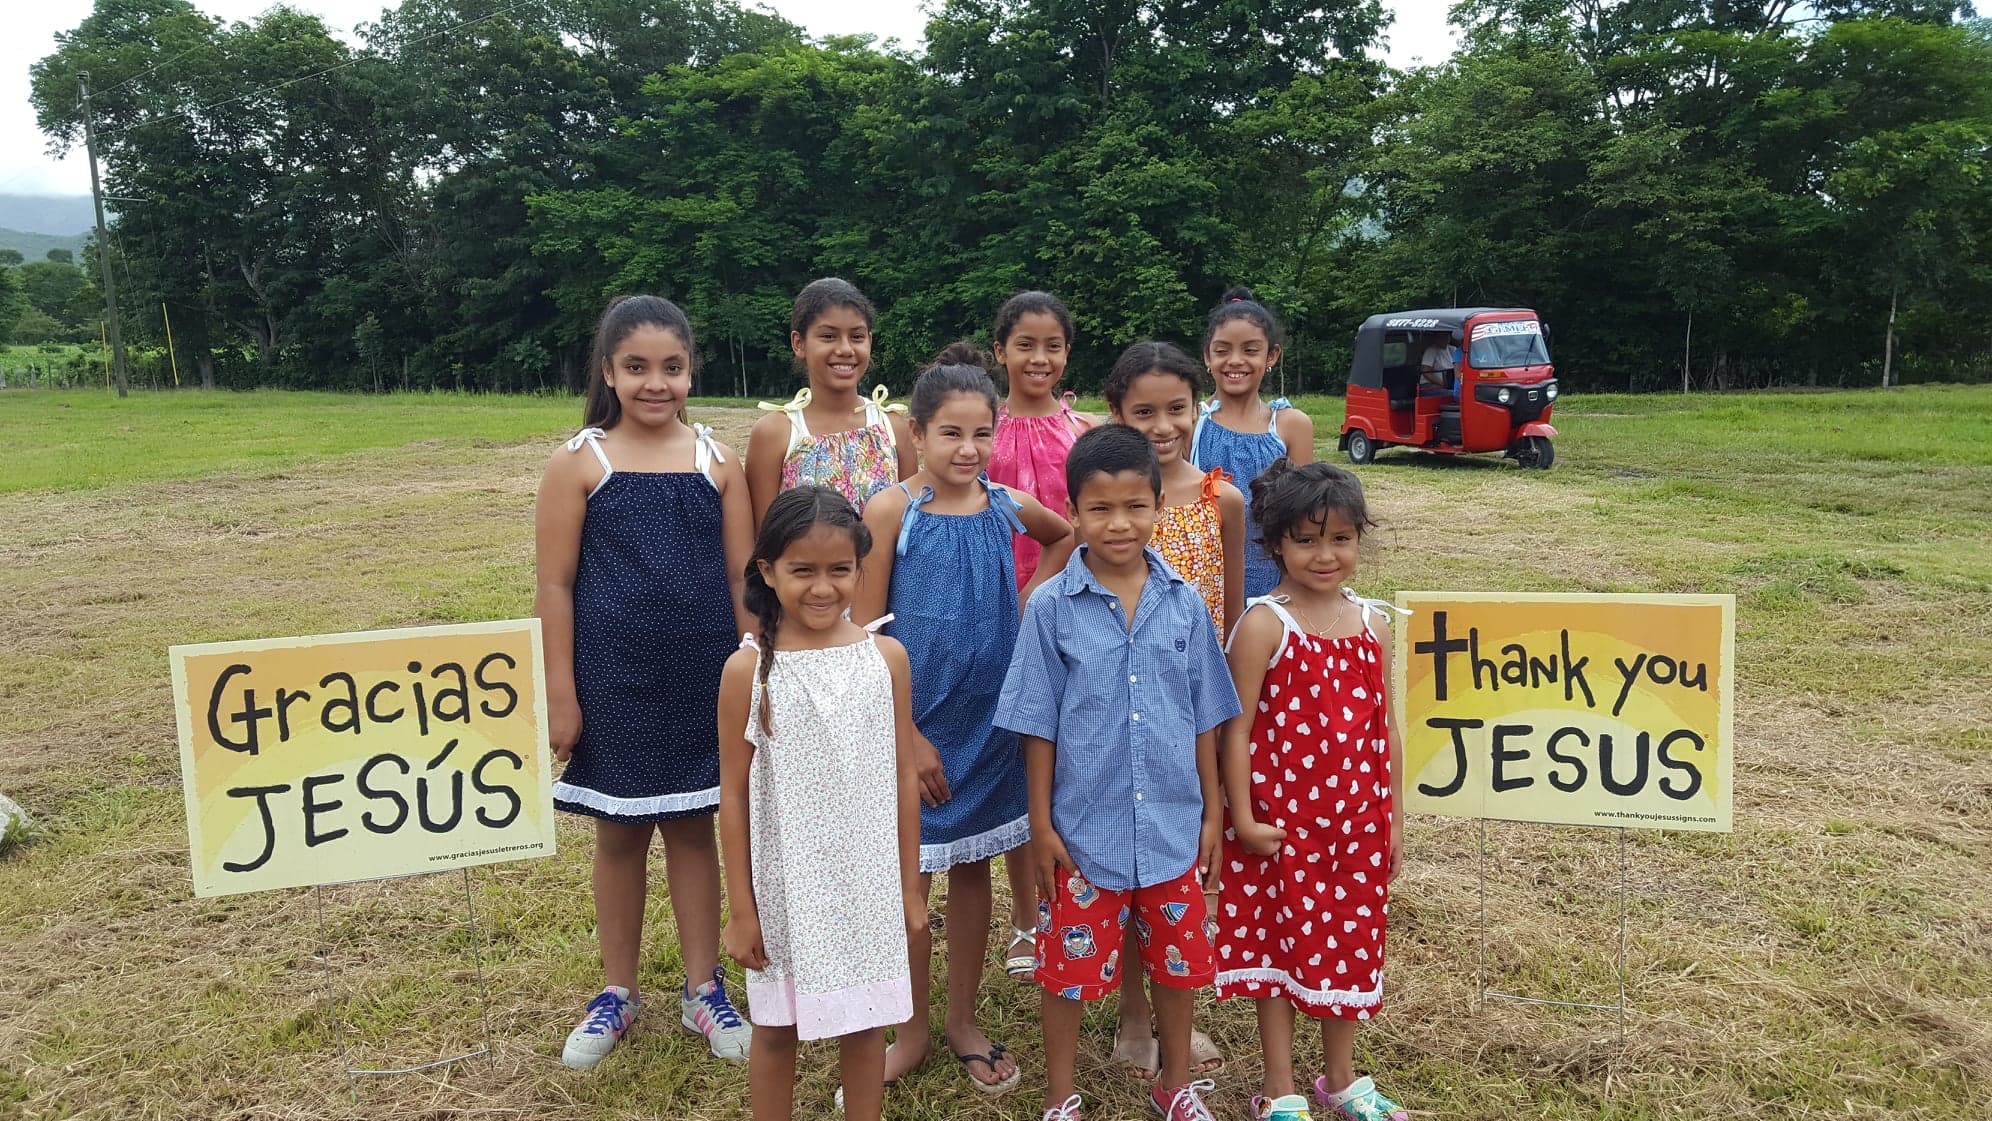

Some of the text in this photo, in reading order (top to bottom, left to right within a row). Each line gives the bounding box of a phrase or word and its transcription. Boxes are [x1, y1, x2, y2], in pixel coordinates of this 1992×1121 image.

[207, 652, 518, 756] Gracias
[1613, 653, 1708, 717] you
[1417, 717, 1705, 801] JESUS
[222, 738, 523, 873] JESÚS
[1593, 810, 1717, 824] www.thankyoujesussigns.com
[428, 841, 544, 862] www.graciasjesusletreros.org
